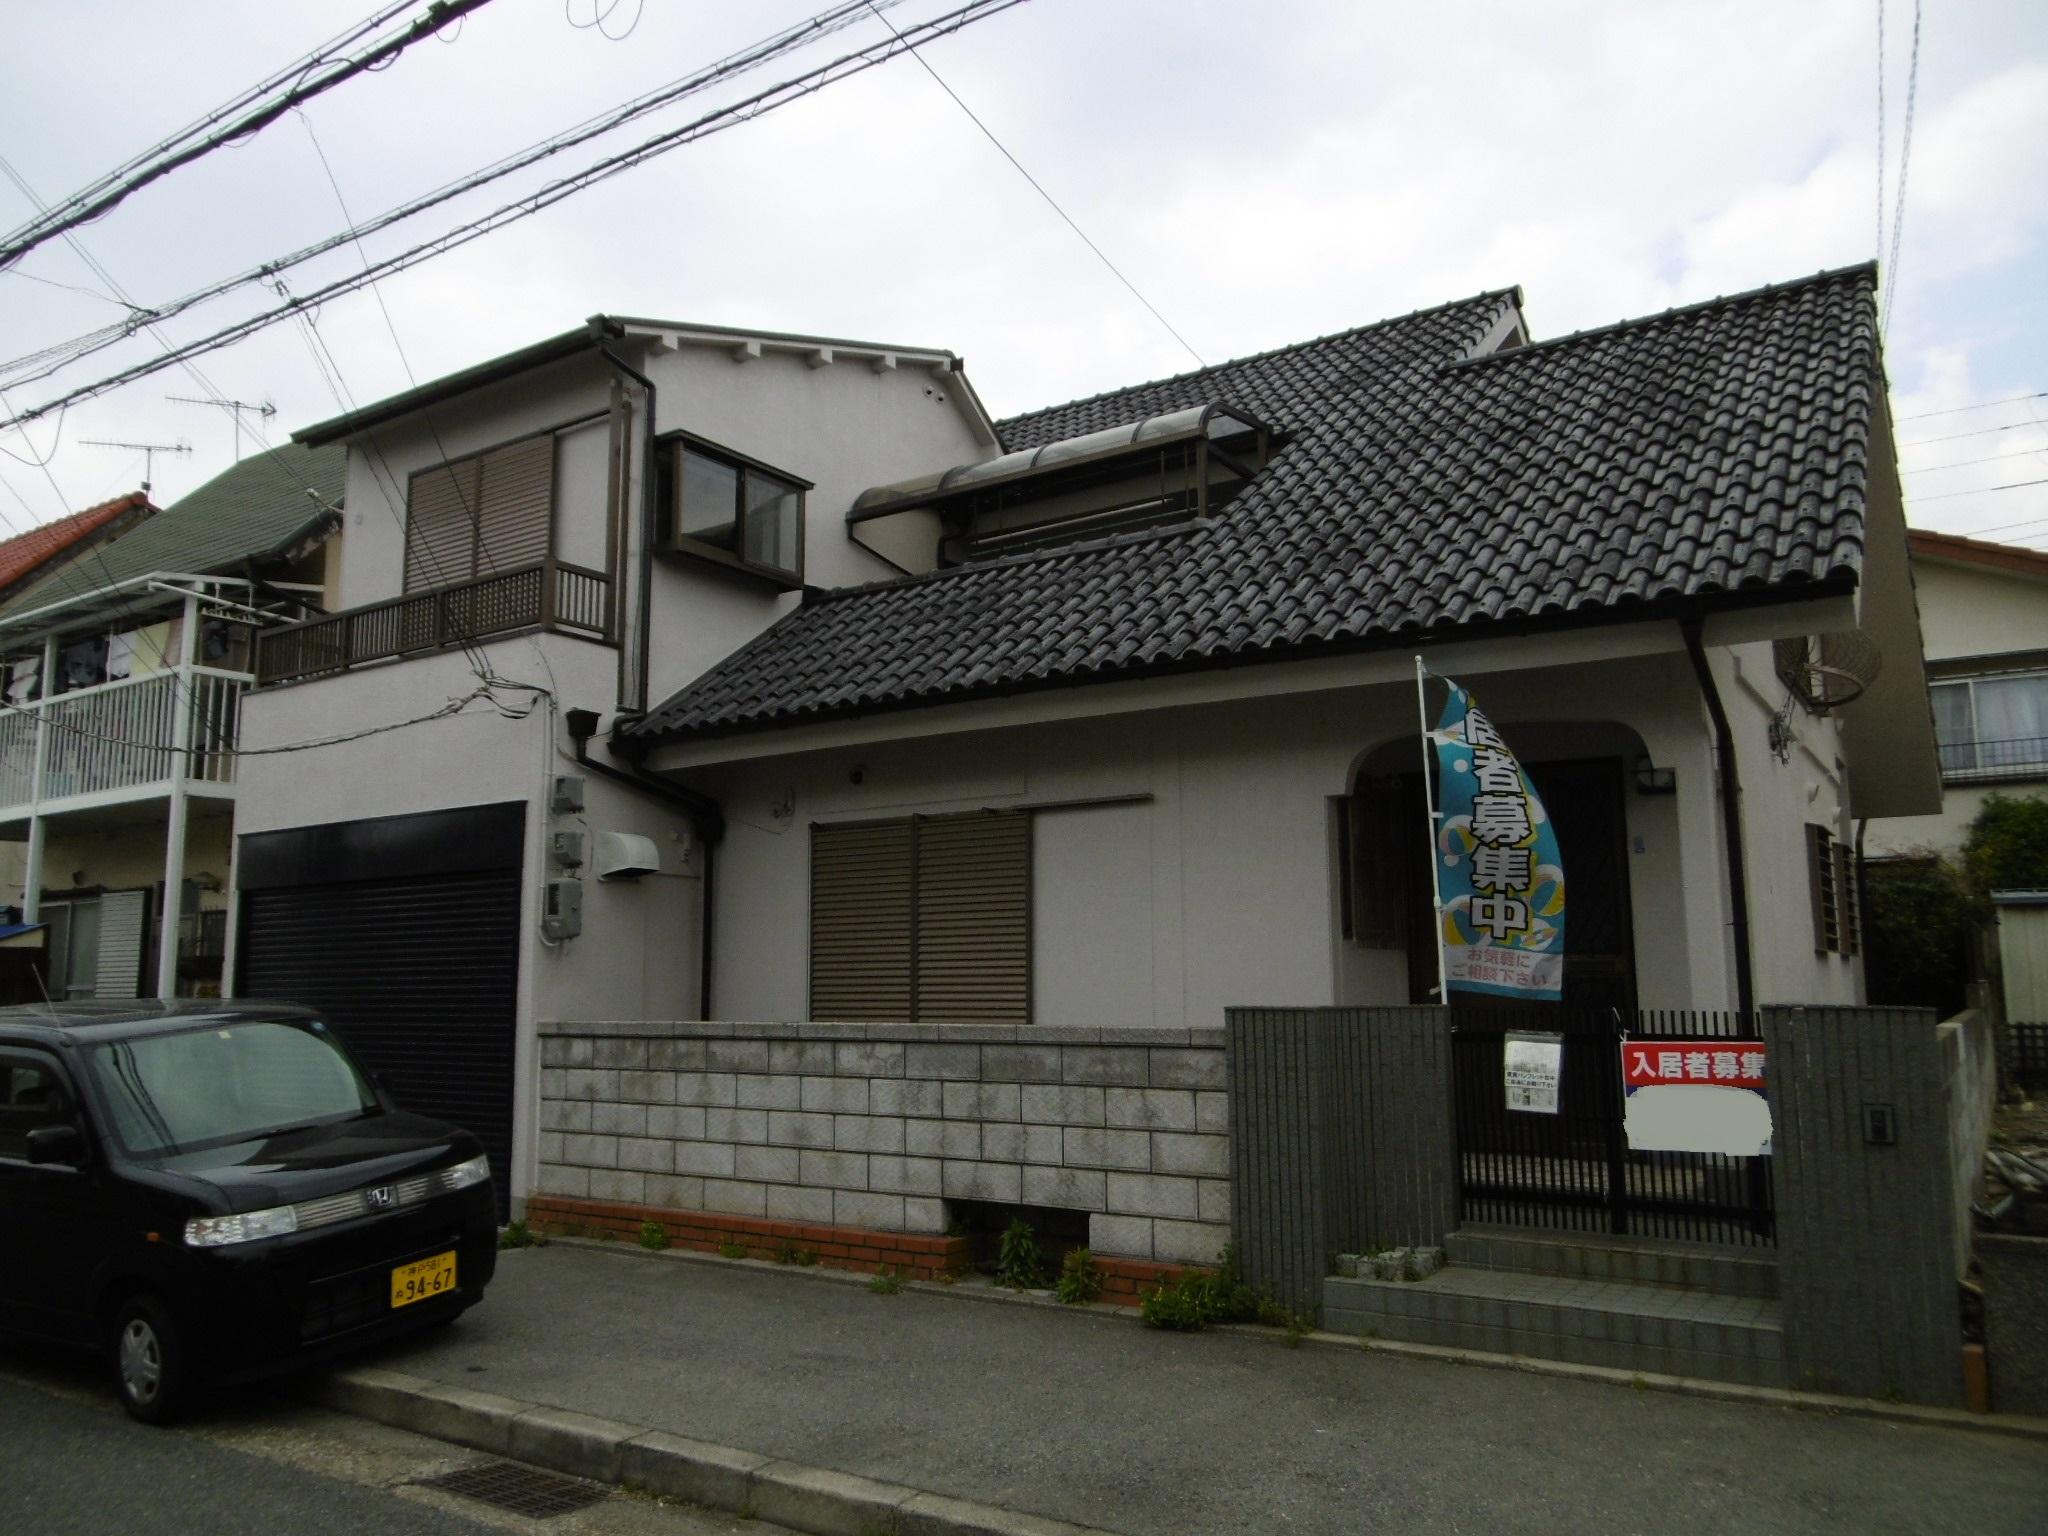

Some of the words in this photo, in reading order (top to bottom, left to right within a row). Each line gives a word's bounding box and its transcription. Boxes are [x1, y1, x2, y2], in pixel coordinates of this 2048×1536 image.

[1467, 949, 1530, 968] お気軽に
[1452, 964, 1547, 986] ご相談下さい
[1631, 1051, 1765, 1079] 入居者募集
[406, 1267, 452, 1300] 94-67
